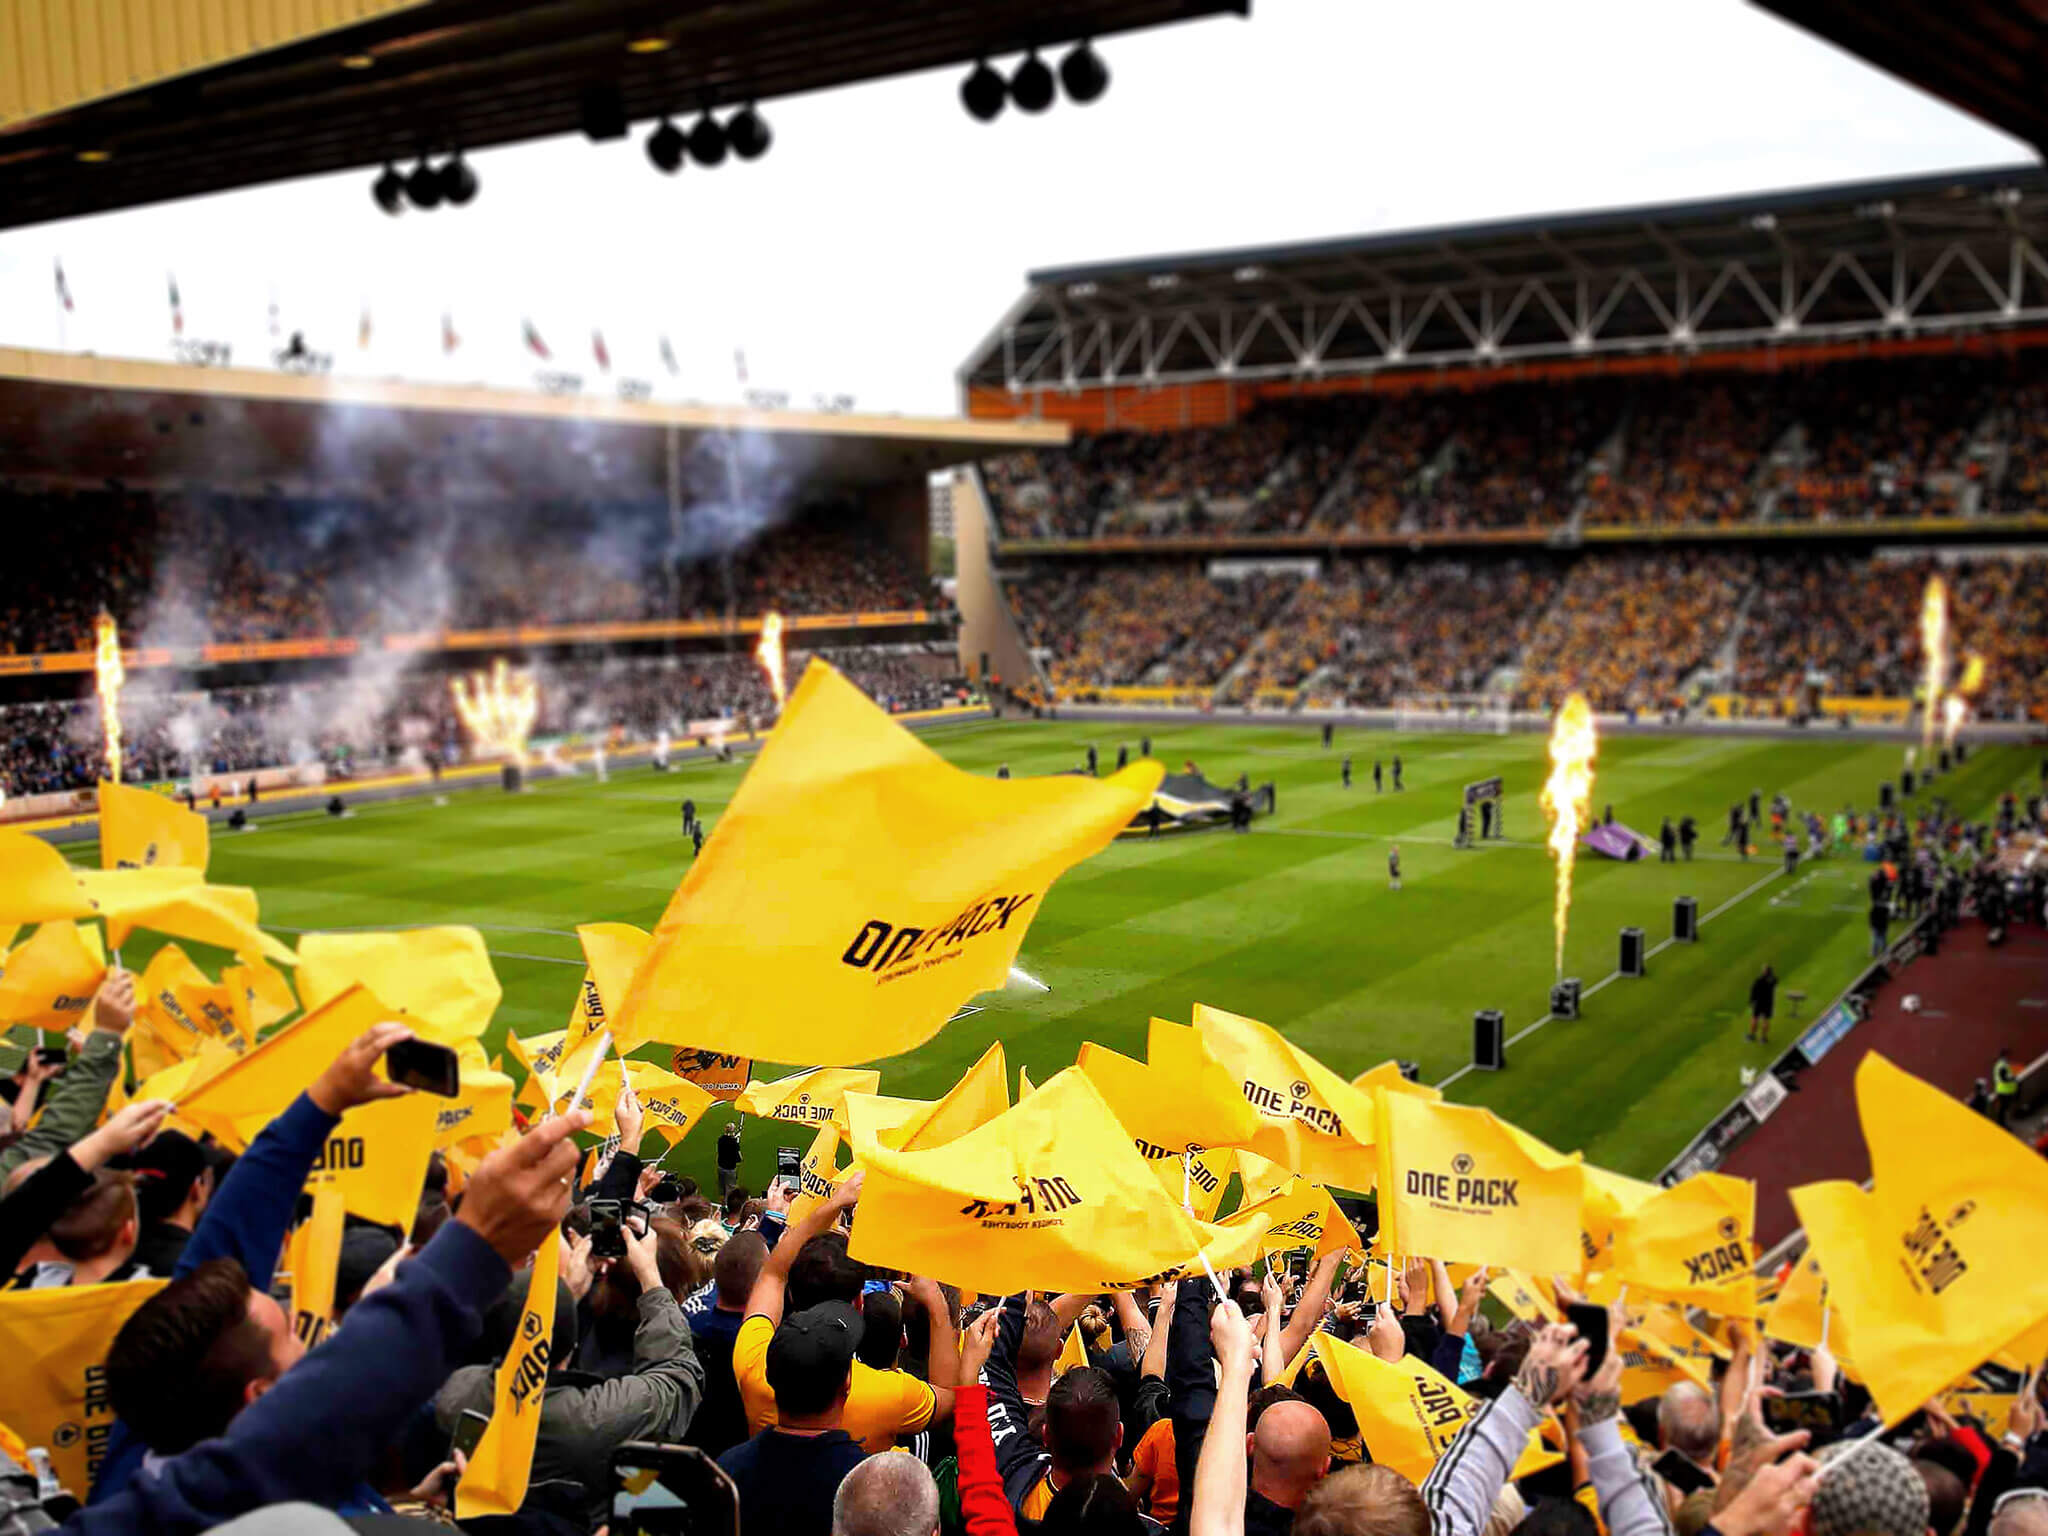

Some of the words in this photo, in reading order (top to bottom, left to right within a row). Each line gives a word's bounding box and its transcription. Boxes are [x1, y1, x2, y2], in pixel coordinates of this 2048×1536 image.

[926, 893, 1034, 952] PACK
[1243, 1080, 1285, 1112] ONE
[1289, 1100, 1343, 1137] PACK
[1407, 1169, 1450, 1201] ONE
[1457, 1177, 1519, 1207] PACK
[1290, 1220, 1324, 1240] PAC
